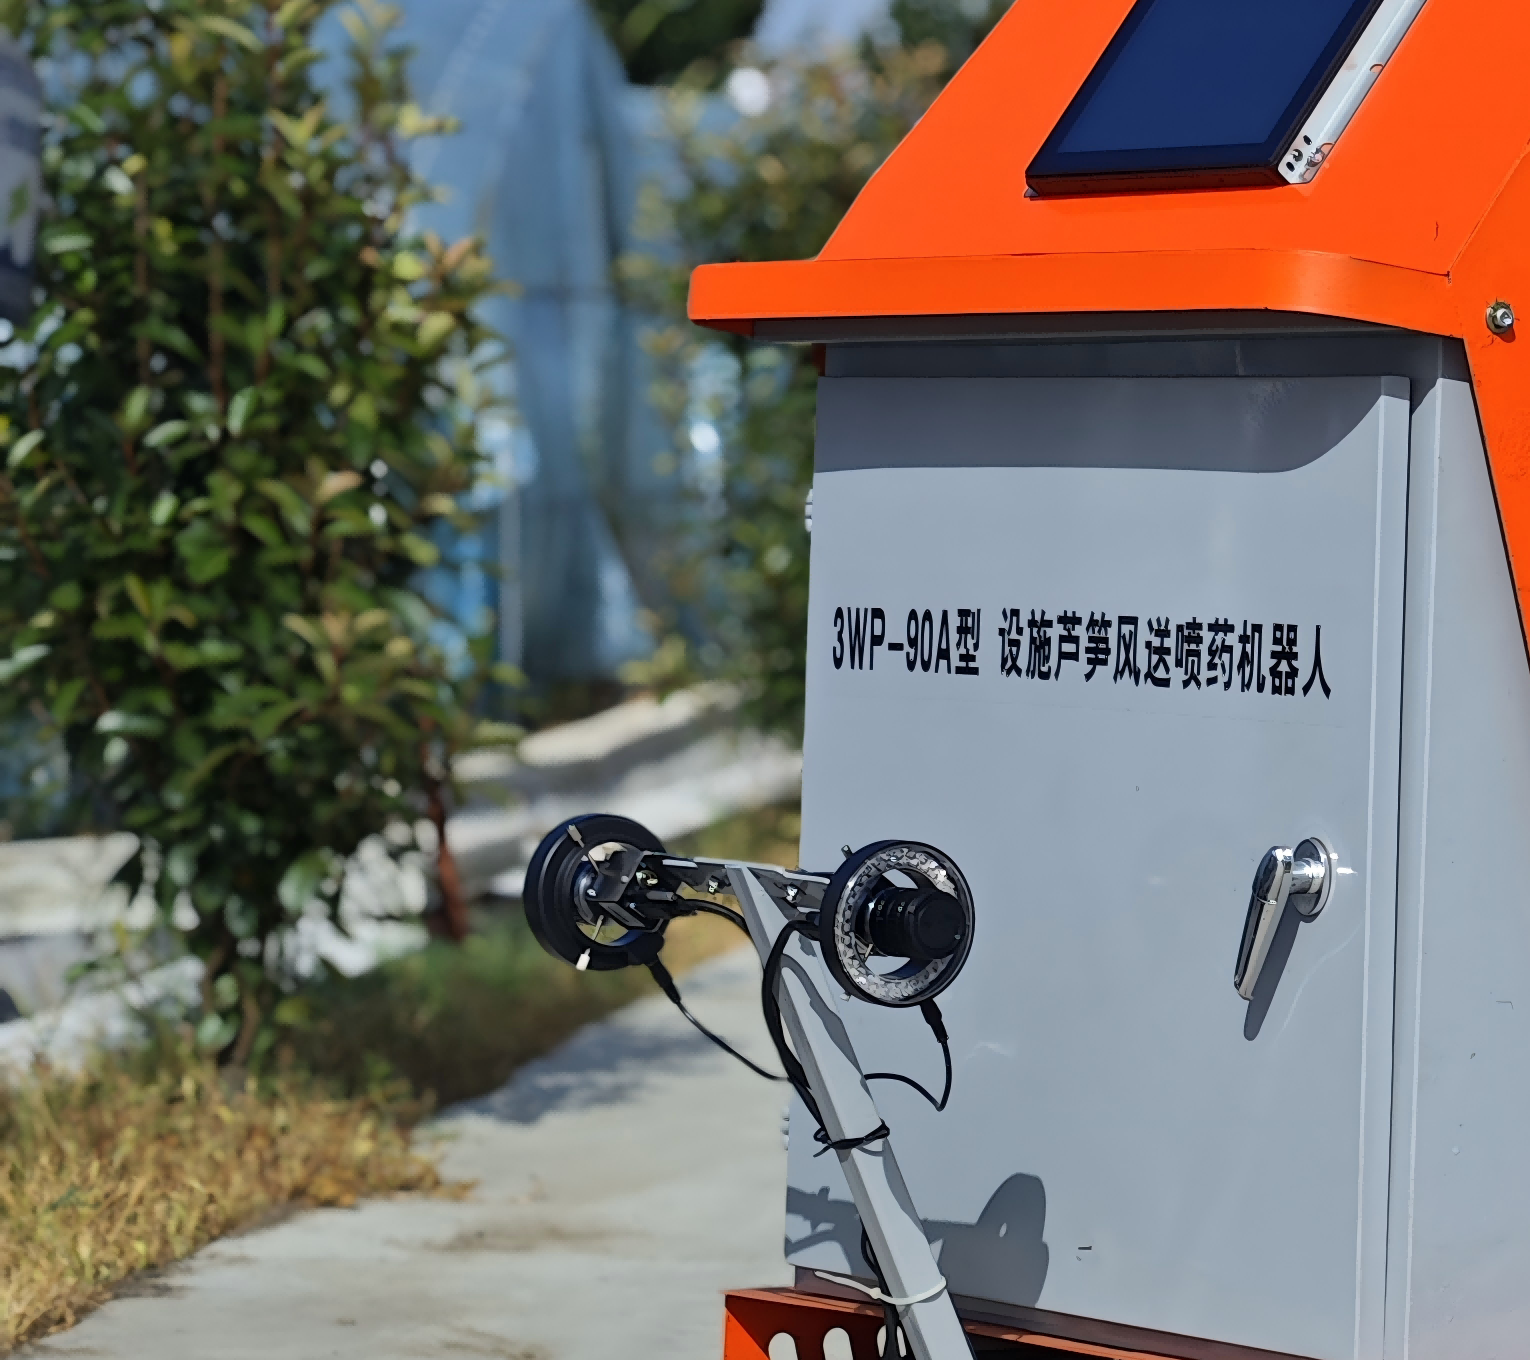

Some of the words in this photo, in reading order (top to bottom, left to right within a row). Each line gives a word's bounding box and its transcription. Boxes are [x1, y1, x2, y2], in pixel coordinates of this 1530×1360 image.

[833, 606, 981, 676] 3WP-90A型
[997, 607, 1332, 700] 设施芦笋风送喷药机器人
